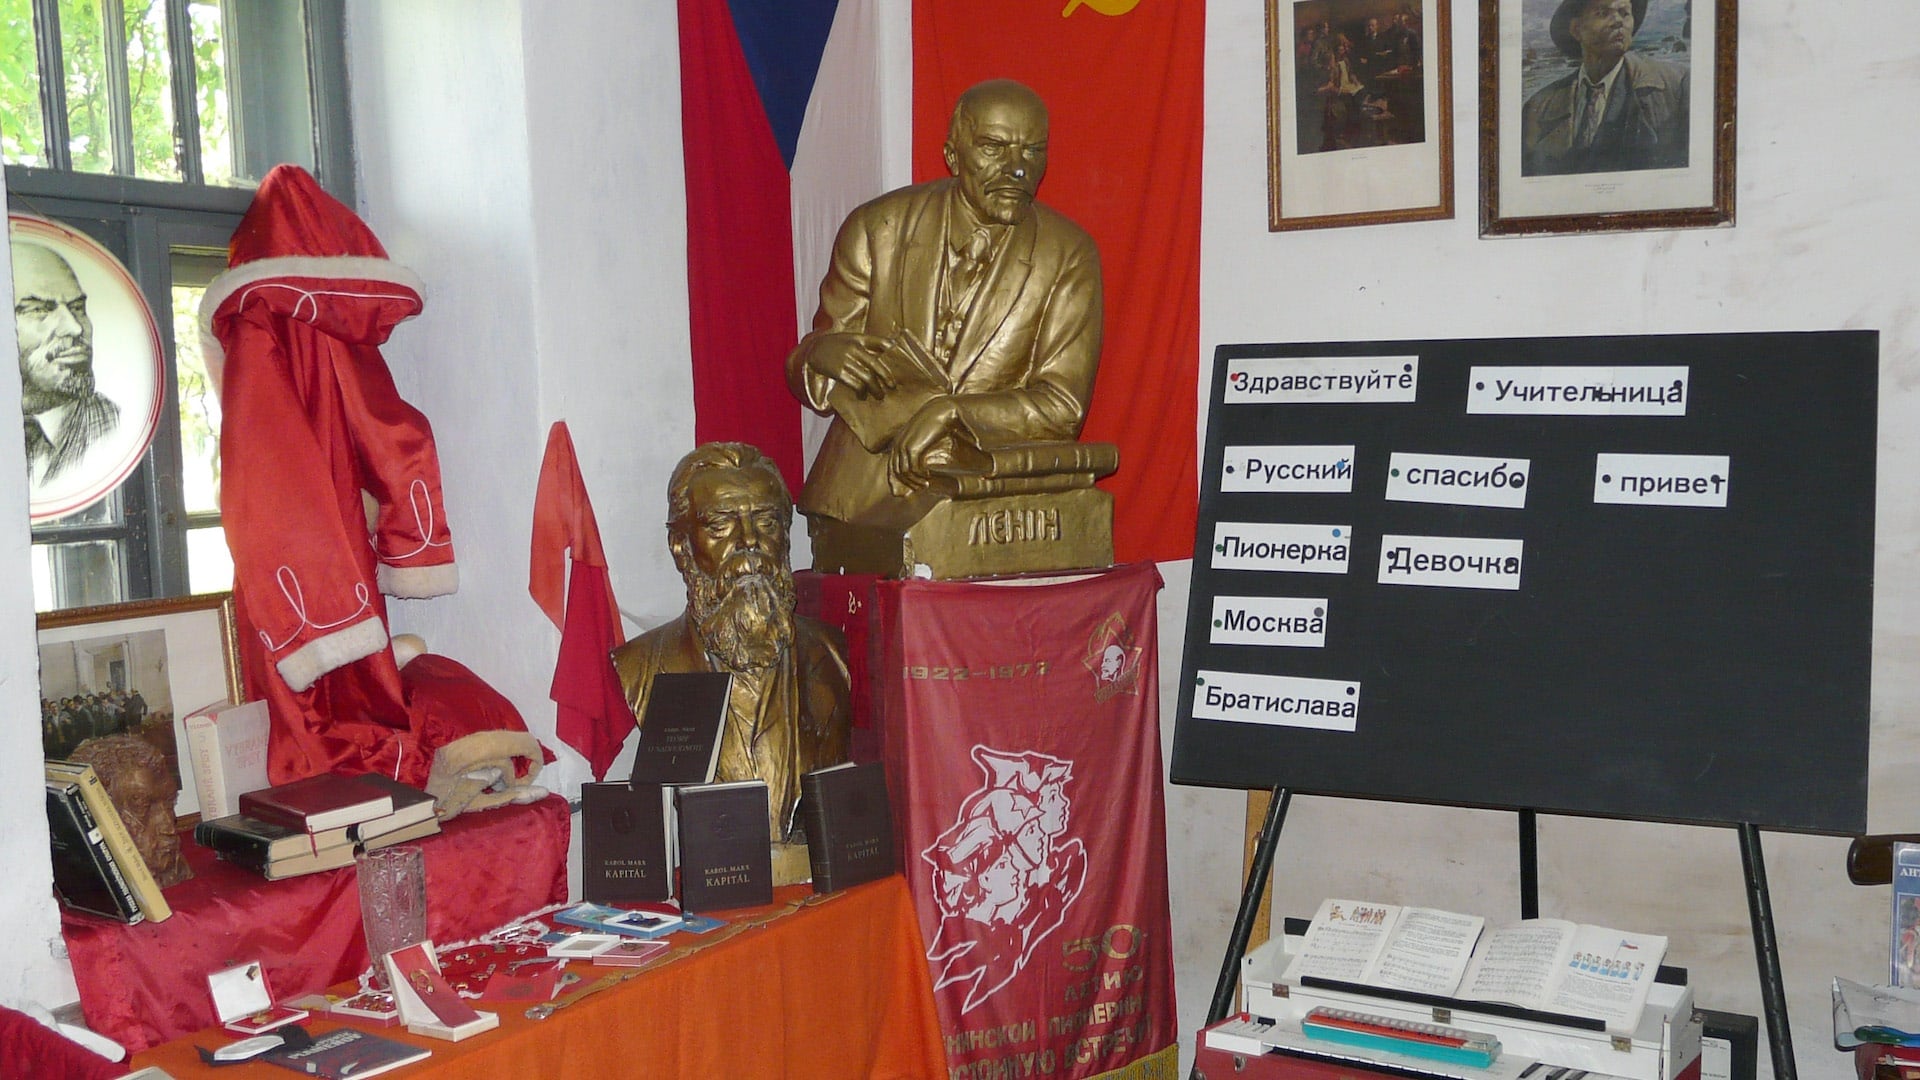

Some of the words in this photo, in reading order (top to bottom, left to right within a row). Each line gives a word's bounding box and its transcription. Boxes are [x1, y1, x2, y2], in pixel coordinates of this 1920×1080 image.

[1234, 369, 1413, 395] Здравствуйте
[1495, 379, 1683, 406] Учительница
[1246, 458, 1352, 484] Русский
[1406, 462, 1526, 489] спасибо
[1620, 475, 1727, 497] привет
[1221, 536, 1347, 564] Пионерка
[1387, 547, 1520, 575] Девочка
[1223, 609, 1324, 634] Москва
[1205, 686, 1356, 719] Братислава
[605, 869, 647, 879] KAPITÁL
[705, 873, 751, 887] KAPITÁL
[943, 1018, 1036, 1057] НИНСКОЙ
